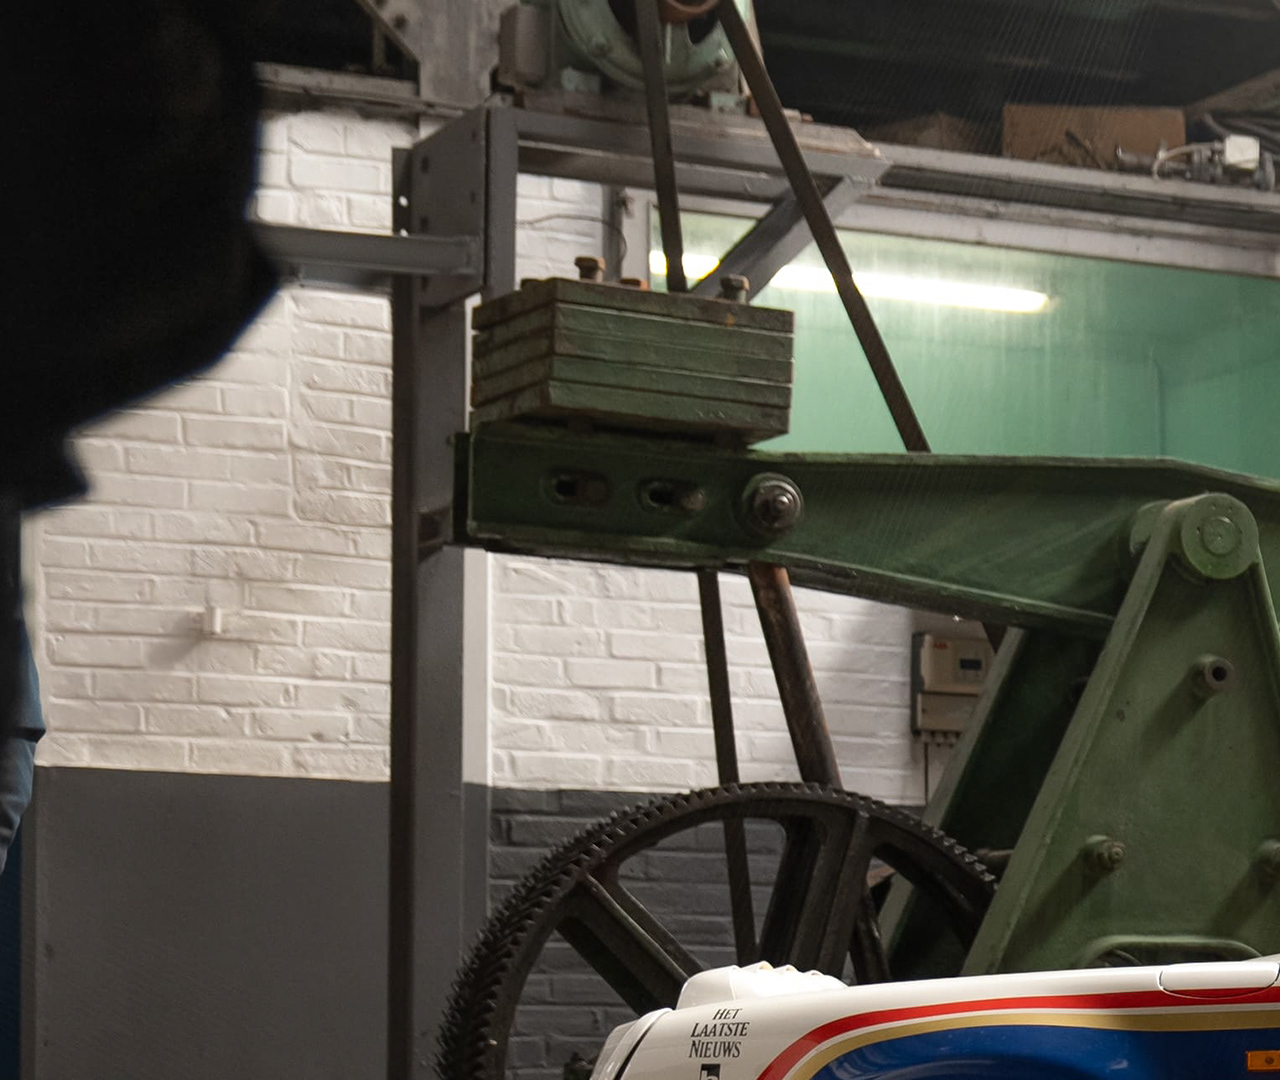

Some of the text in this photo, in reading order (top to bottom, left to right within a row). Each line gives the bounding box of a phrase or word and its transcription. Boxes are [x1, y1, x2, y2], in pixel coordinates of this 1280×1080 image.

[713, 1008, 743, 1020] HET
[690, 1021, 750, 1037] LAATSTE
[688, 1040, 742, 1059] NIEUWS
